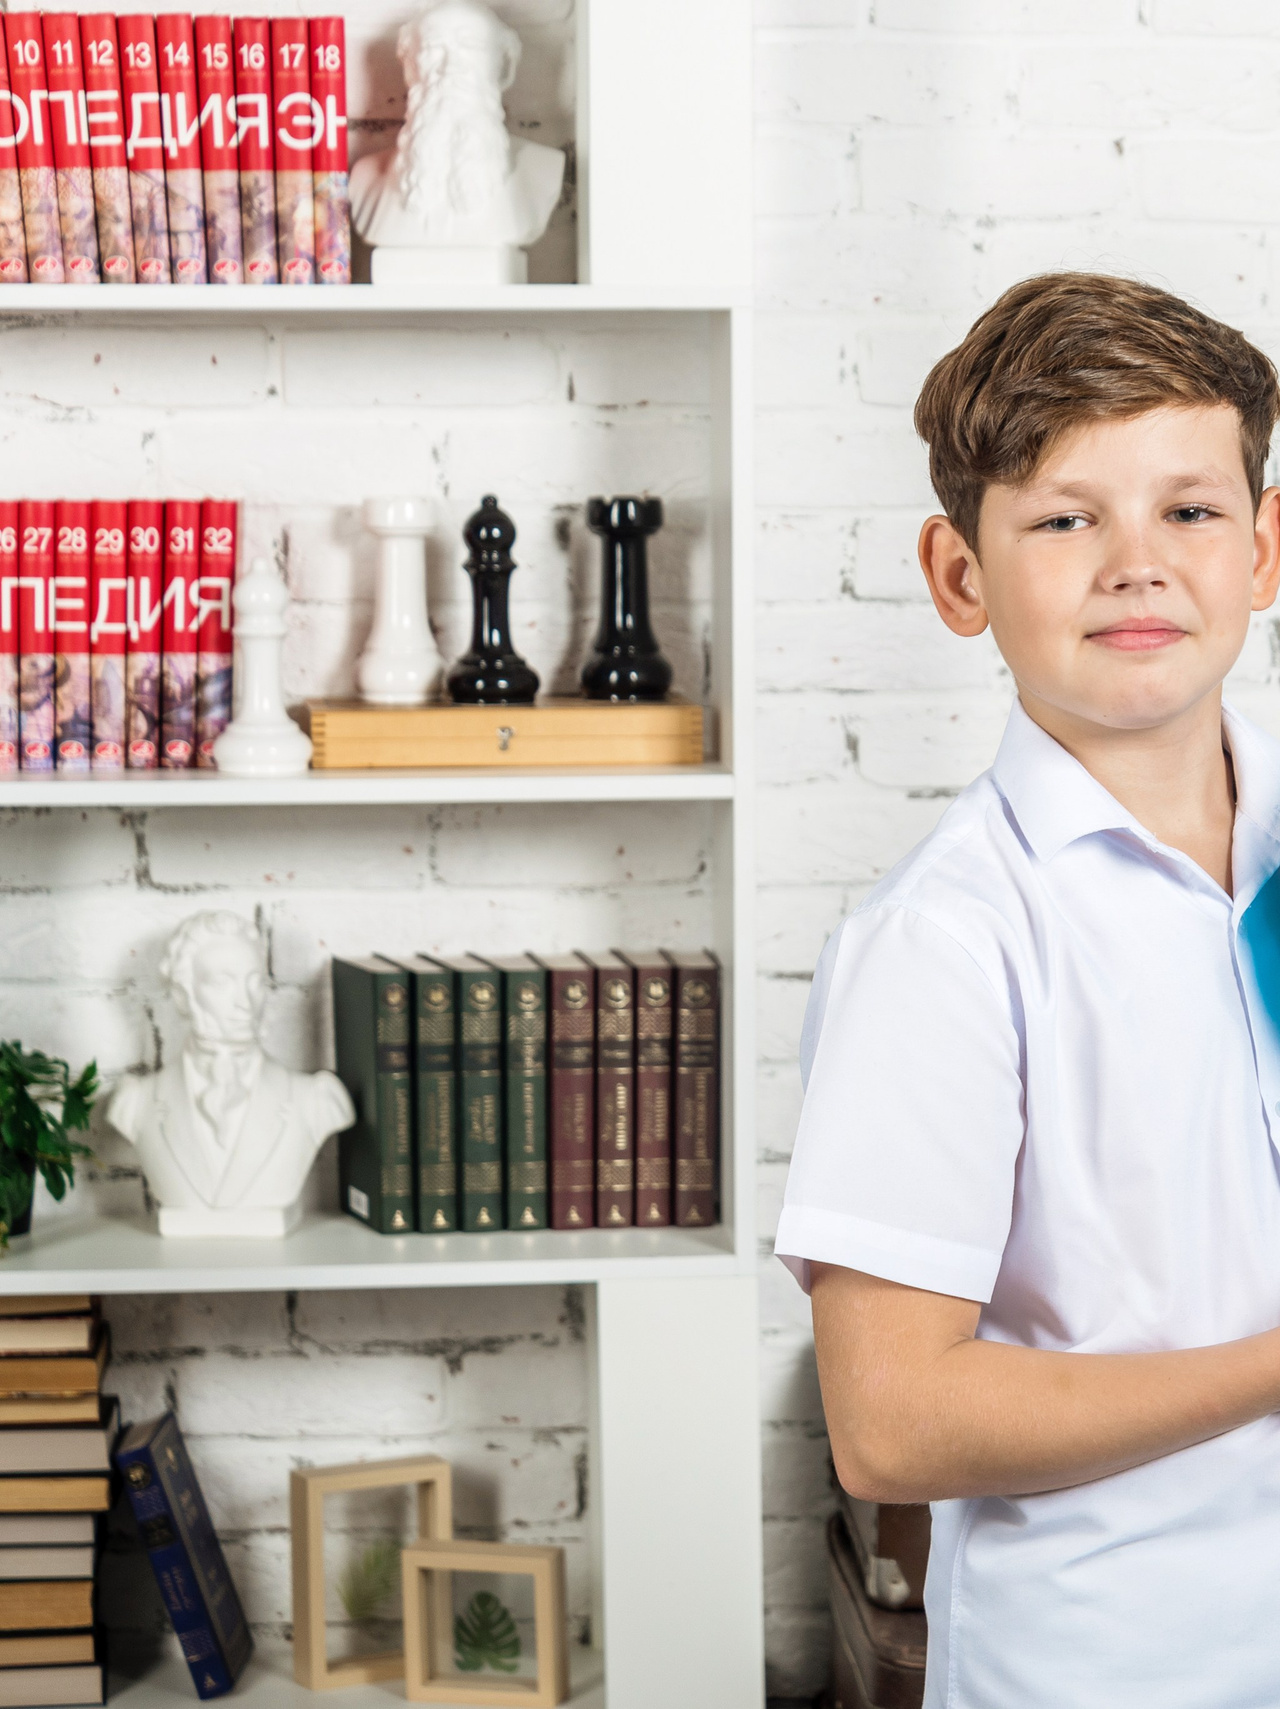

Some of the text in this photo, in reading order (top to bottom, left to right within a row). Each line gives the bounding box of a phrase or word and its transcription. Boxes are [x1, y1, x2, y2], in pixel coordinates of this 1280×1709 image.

[13, 39, 40, 66] 10
[52, 39, 74, 65] 11
[87, 39, 114, 66] 12
[125, 42, 152, 69] 13
[163, 41, 190, 68] 14
[202, 43, 229, 70] 15
[240, 43, 265, 69] 16
[279, 43, 305, 69] 17
[315, 44, 341, 71] 18
[0, 527, 16, 553] 6
[23, 527, 51, 553] 27
[58, 527, 87, 553] 28
[95, 528, 124, 554] 29
[131, 527, 160, 553] 30
[170, 527, 194, 553] 31
[204, 527, 232, 553] 32
[1, 576, 230, 643] ПЕДИЯ
